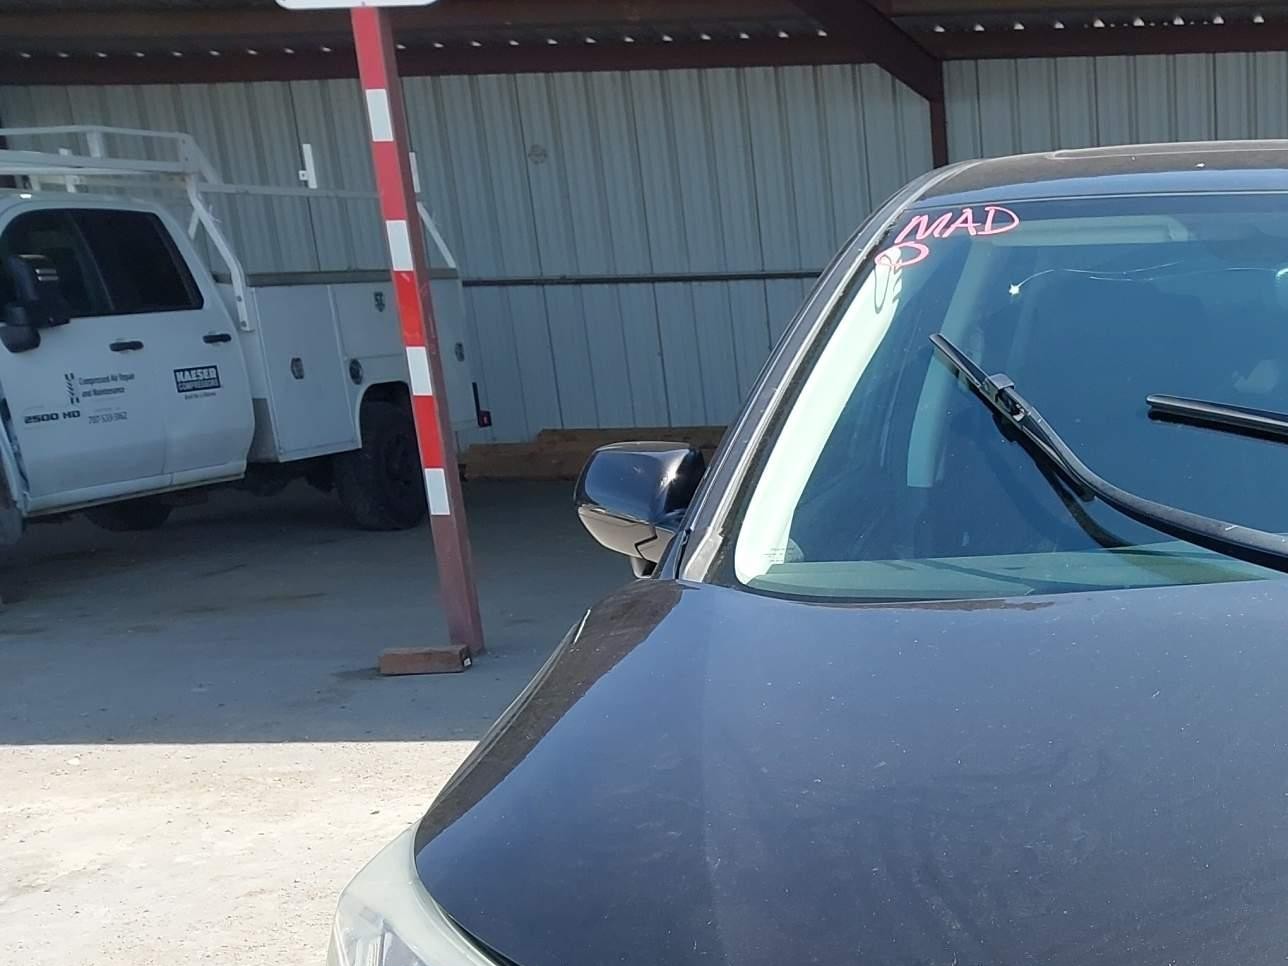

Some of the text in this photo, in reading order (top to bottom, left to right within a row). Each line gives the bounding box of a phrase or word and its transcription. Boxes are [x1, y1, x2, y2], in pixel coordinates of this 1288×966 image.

[894, 205, 1021, 244] MAD
[24, 410, 81, 424] 2500 HD
